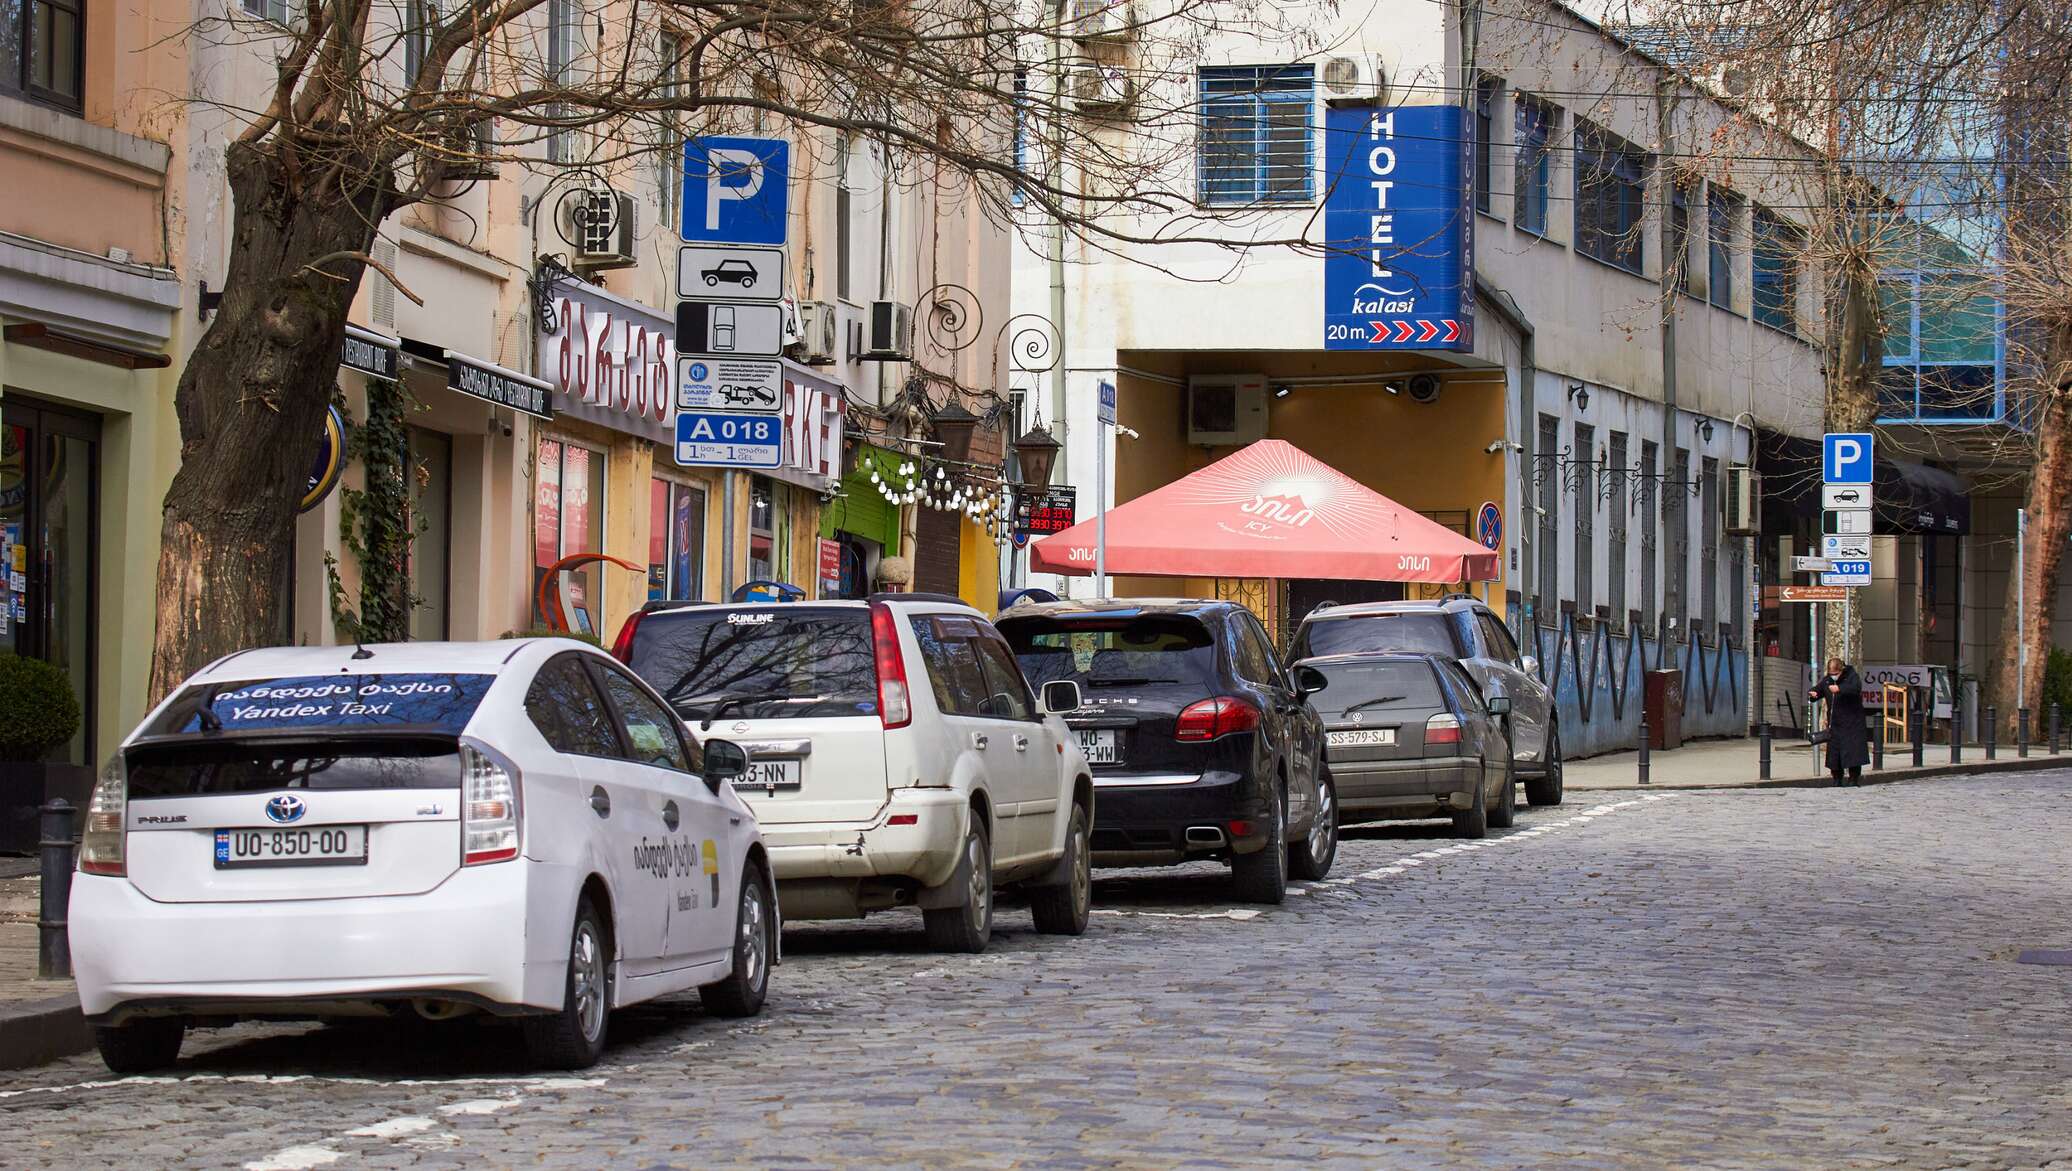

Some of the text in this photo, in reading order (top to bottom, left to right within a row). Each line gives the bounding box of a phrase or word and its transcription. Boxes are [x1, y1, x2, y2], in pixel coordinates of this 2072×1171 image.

[706, 148, 764, 230] P
[1369, 112, 1396, 278] HOTEL
[1352, 297, 1415, 314] kalasi
[1327, 325, 1369, 340] 20 m.
[556, 297, 670, 424] მარკეტ
[690, 418, 769, 440] A 018
[783, 379, 847, 480] RKET
[689, 445, 699, 459] 1
[727, 446, 737, 460] 1
[1834, 439, 1861, 478] P
[1241, 495, 1316, 528] აისი
[1244, 520, 1272, 532] ICY
[1398, 555, 1430, 571] აისი
[1842, 563, 1866, 574] 019
[727, 613, 775, 624] SUNLINE
[215, 682, 453, 701] იანდექს ტაქსი
[232, 701, 394, 720] Yandex Taxi
[1330, 731, 1386, 745] SS-579-SJ
[1082, 747, 1113, 761] 3-WW
[732, 763, 786, 783] 3-NN
[138, 815, 187, 824] PRIUS
[216, 848, 229, 858] GE
